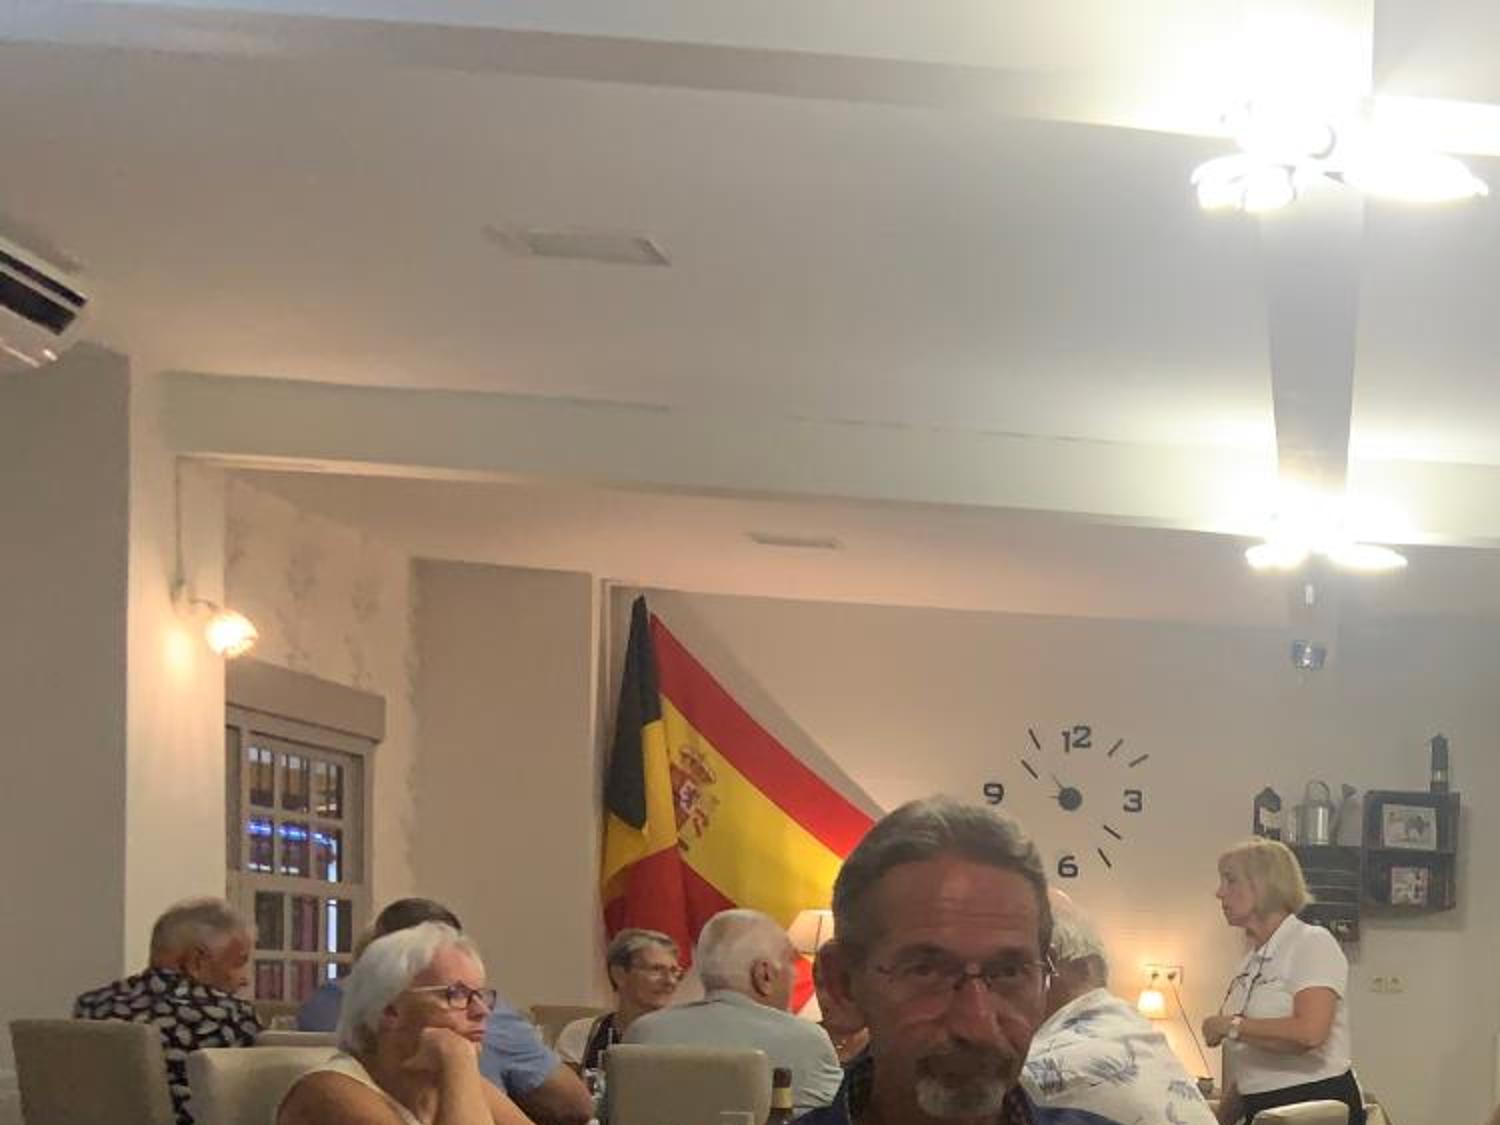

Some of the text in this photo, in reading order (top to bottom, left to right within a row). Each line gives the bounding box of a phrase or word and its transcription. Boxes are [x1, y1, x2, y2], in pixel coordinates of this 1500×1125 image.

[1061, 725, 1092, 753] 12
[983, 783, 1005, 806] 9
[1122, 789, 1143, 812] 3
[1057, 855, 1079, 878] 6
